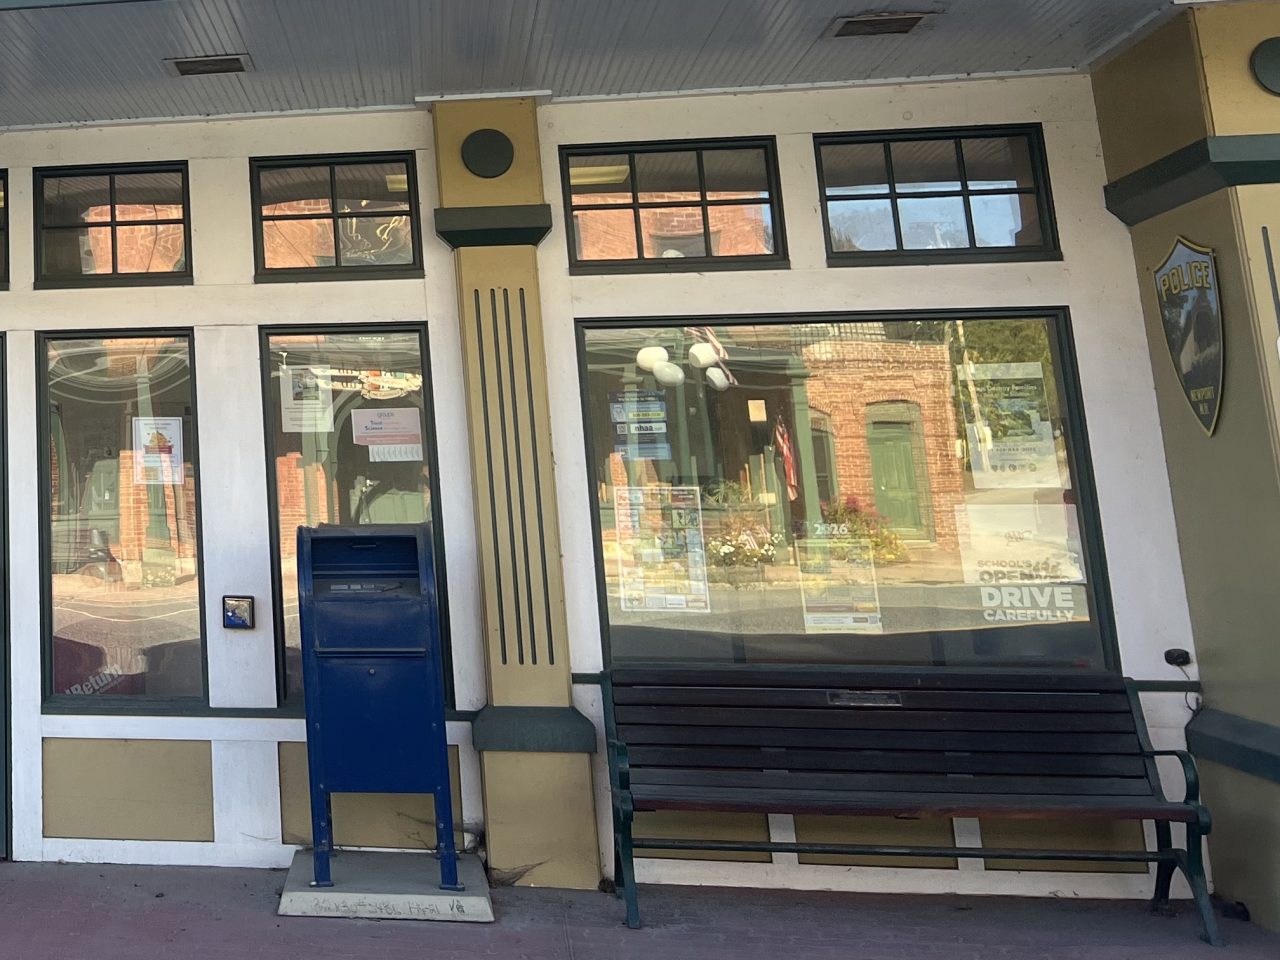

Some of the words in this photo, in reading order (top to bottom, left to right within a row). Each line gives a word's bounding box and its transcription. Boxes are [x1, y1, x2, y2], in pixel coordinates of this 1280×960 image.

[1159, 260, 1211, 302] POLICE
[978, 560, 1032, 569] SCHOOL'S
[979, 570, 1033, 584] OPEN
[980, 586, 1075, 608] DRIVE
[983, 609, 1074, 621] CAREFULLY
